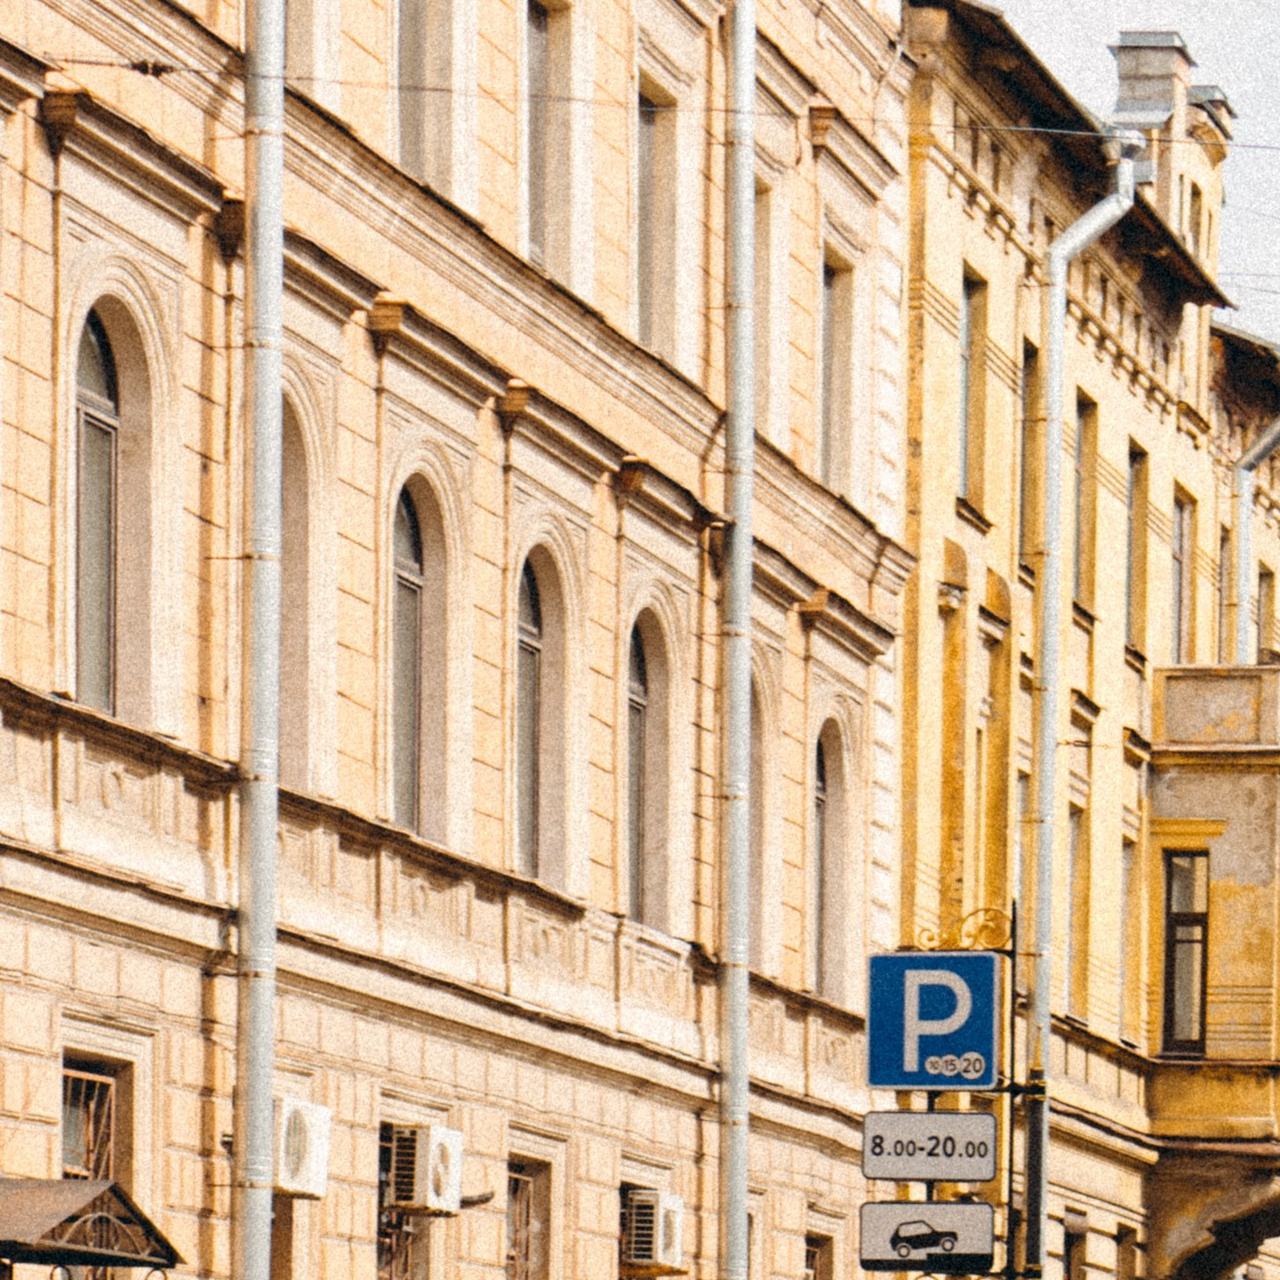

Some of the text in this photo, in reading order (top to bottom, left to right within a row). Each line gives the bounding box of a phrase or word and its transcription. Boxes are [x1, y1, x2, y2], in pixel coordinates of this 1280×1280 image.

[903, 969, 973, 1073] P
[928, 1057, 983, 1073] 10 15 20
[871, 1134, 988, 1159] 8.00-20.00
